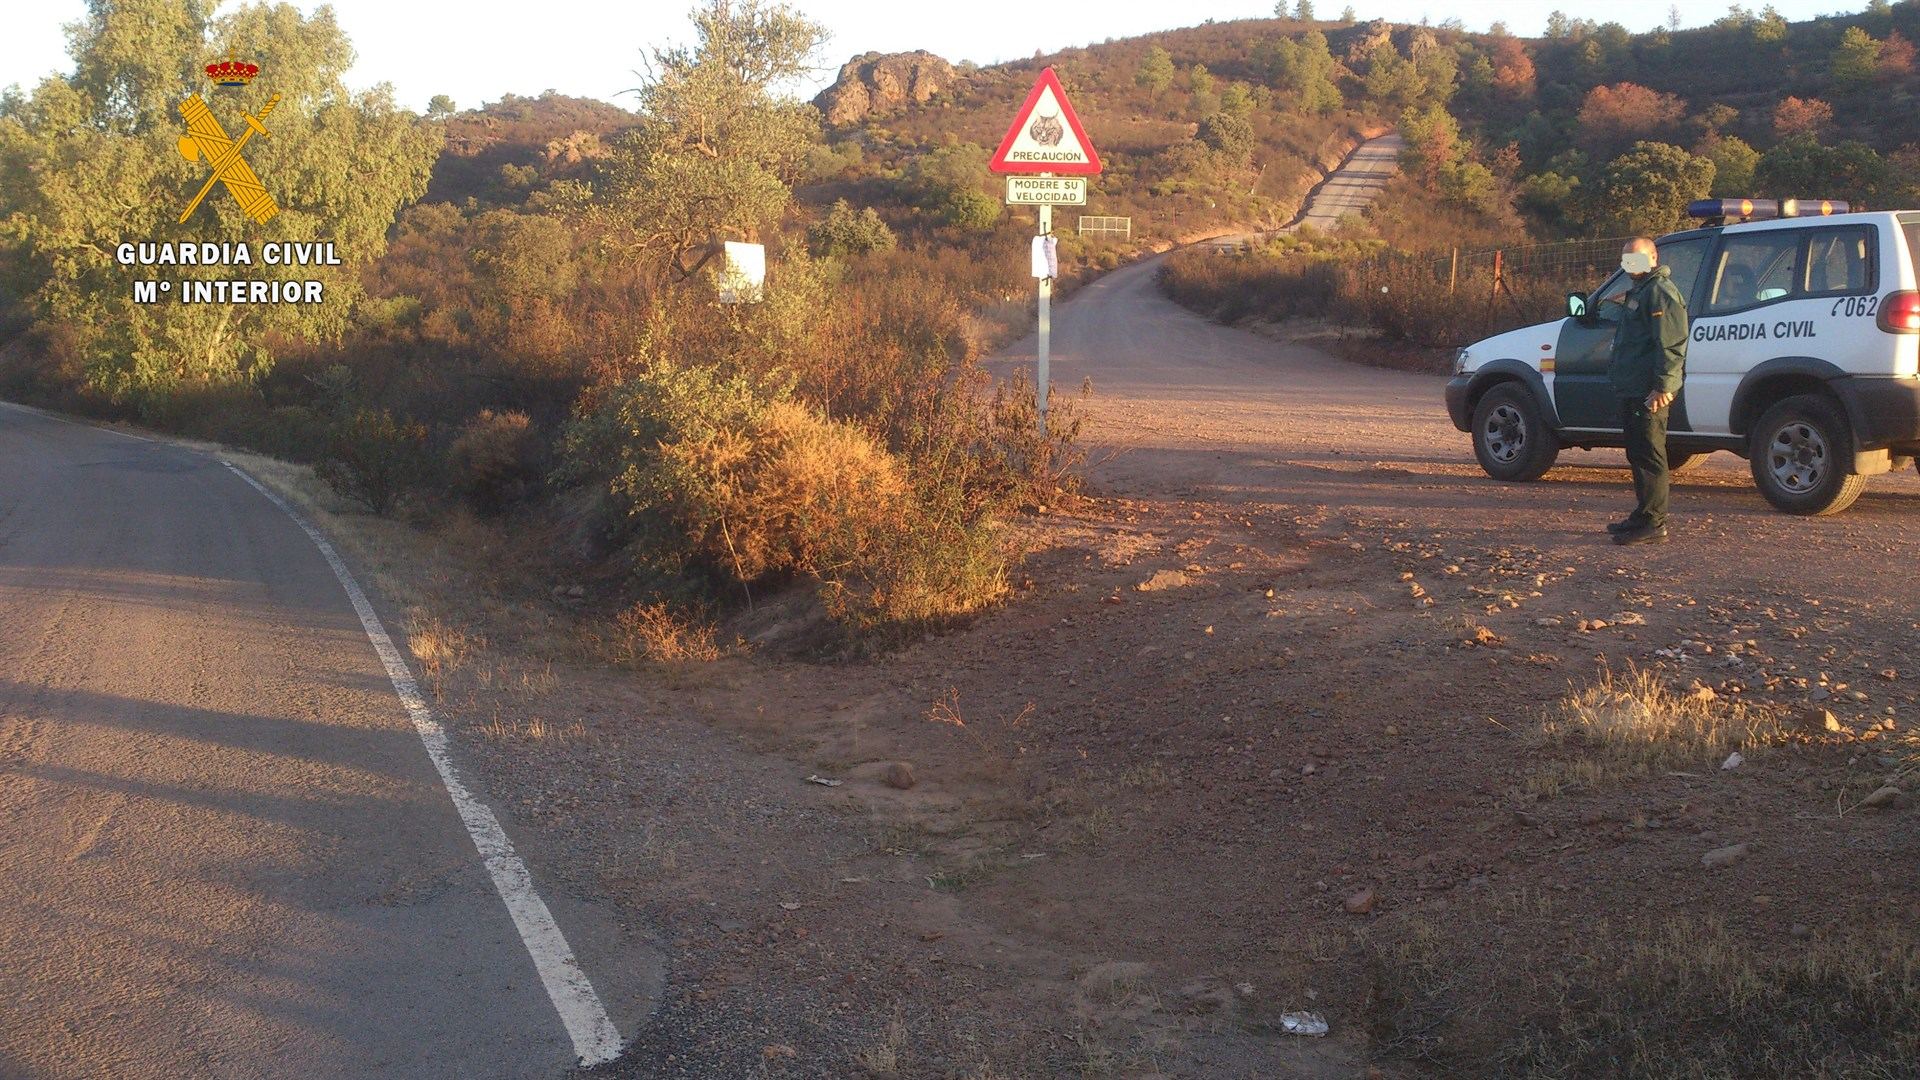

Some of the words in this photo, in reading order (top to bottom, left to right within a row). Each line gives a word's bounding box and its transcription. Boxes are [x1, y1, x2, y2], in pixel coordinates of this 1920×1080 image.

[1015, 180, 1059, 189] MODERE
[1064, 181, 1078, 190] SU
[1016, 192, 1077, 201] VELOCIDAD
[1845, 296, 1877, 317] 062
[1693, 322, 1766, 342] GUARDIA
[1773, 320, 1816, 339] CIVIL
